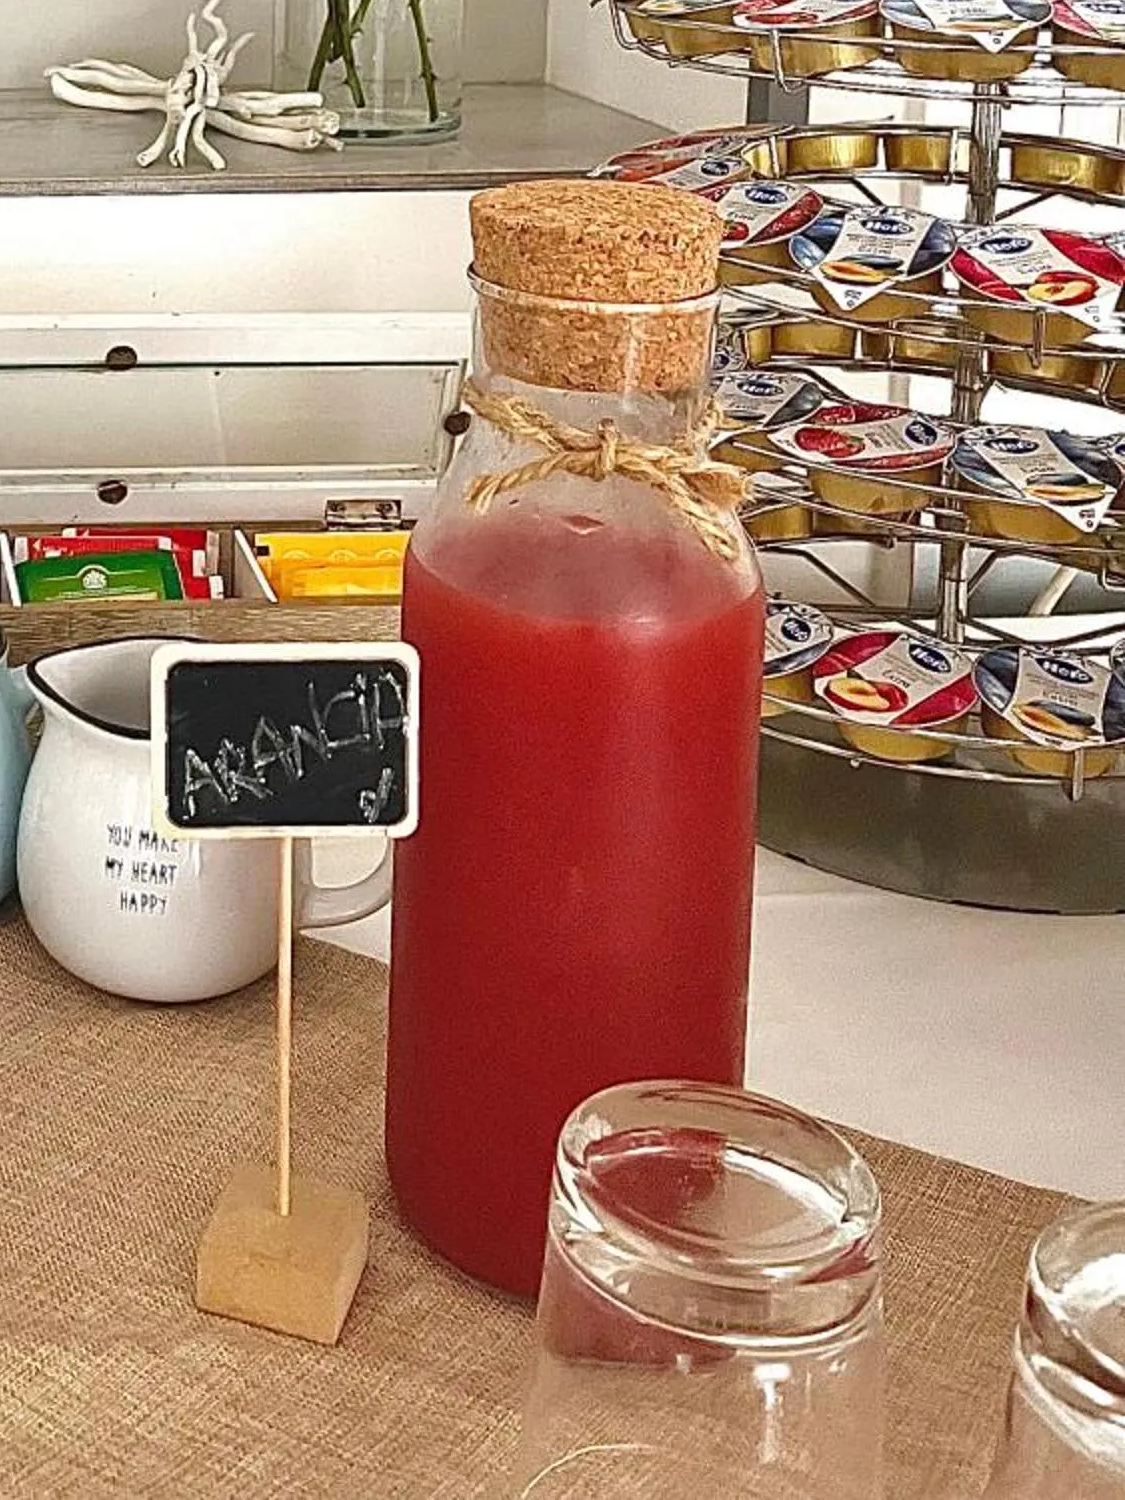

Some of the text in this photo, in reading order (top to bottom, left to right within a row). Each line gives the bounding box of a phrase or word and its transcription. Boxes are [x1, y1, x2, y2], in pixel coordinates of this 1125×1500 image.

[911, 646, 949, 673] Hero
[1042, 661, 1090, 681] Hero
[106, 823, 132, 848] YOU
[105, 856, 177, 886] MY HEART
[120, 890, 167, 916] HAPPY
